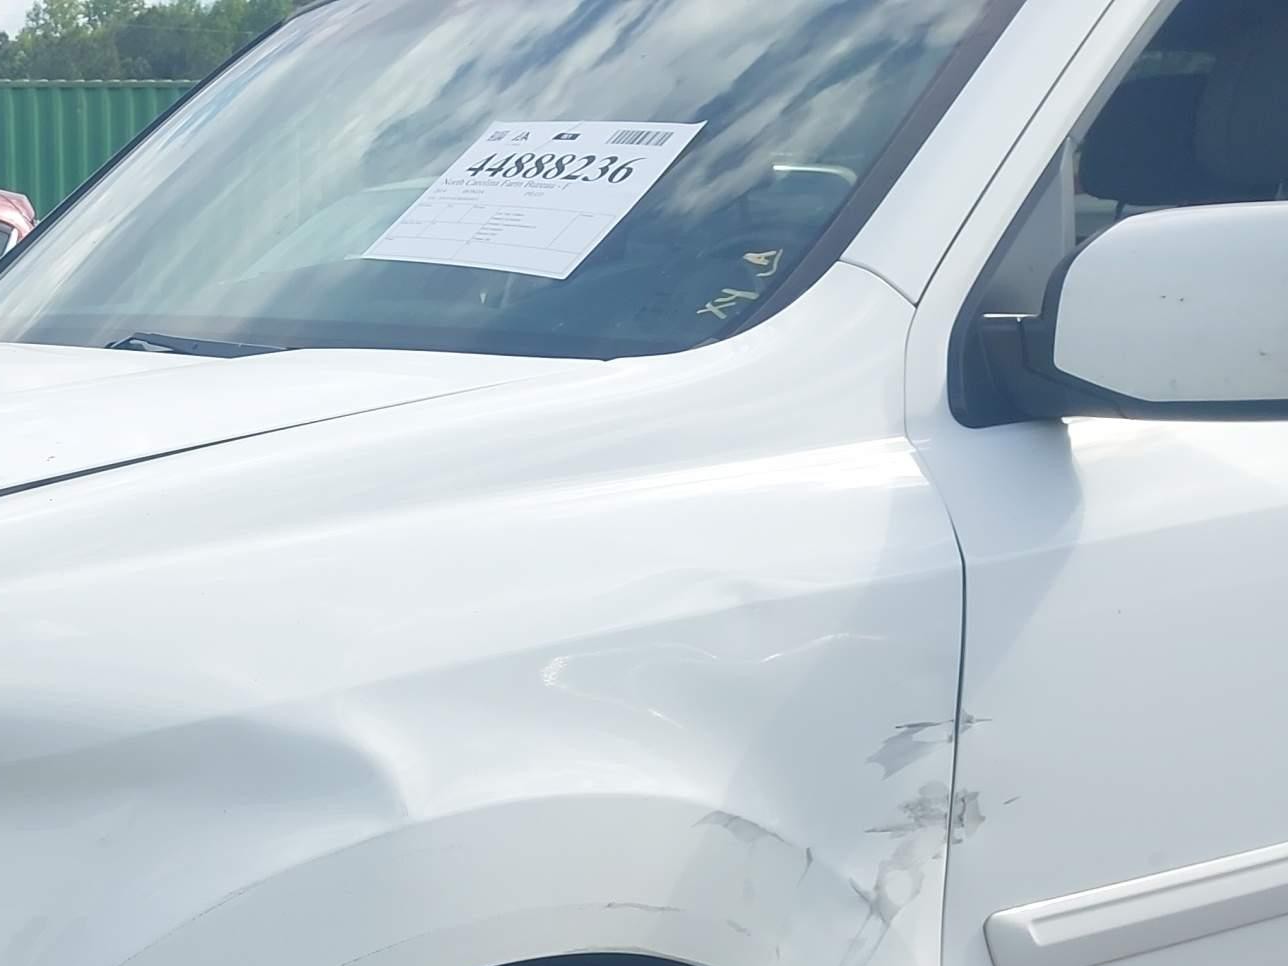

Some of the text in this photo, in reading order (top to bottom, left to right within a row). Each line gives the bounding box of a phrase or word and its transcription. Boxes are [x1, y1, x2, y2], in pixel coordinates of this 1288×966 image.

[466, 153, 648, 184] 44888236
[465, 179, 500, 187] Carolina
[500, 180, 524, 188] Farm
[523, 181, 554, 189] Bureau
